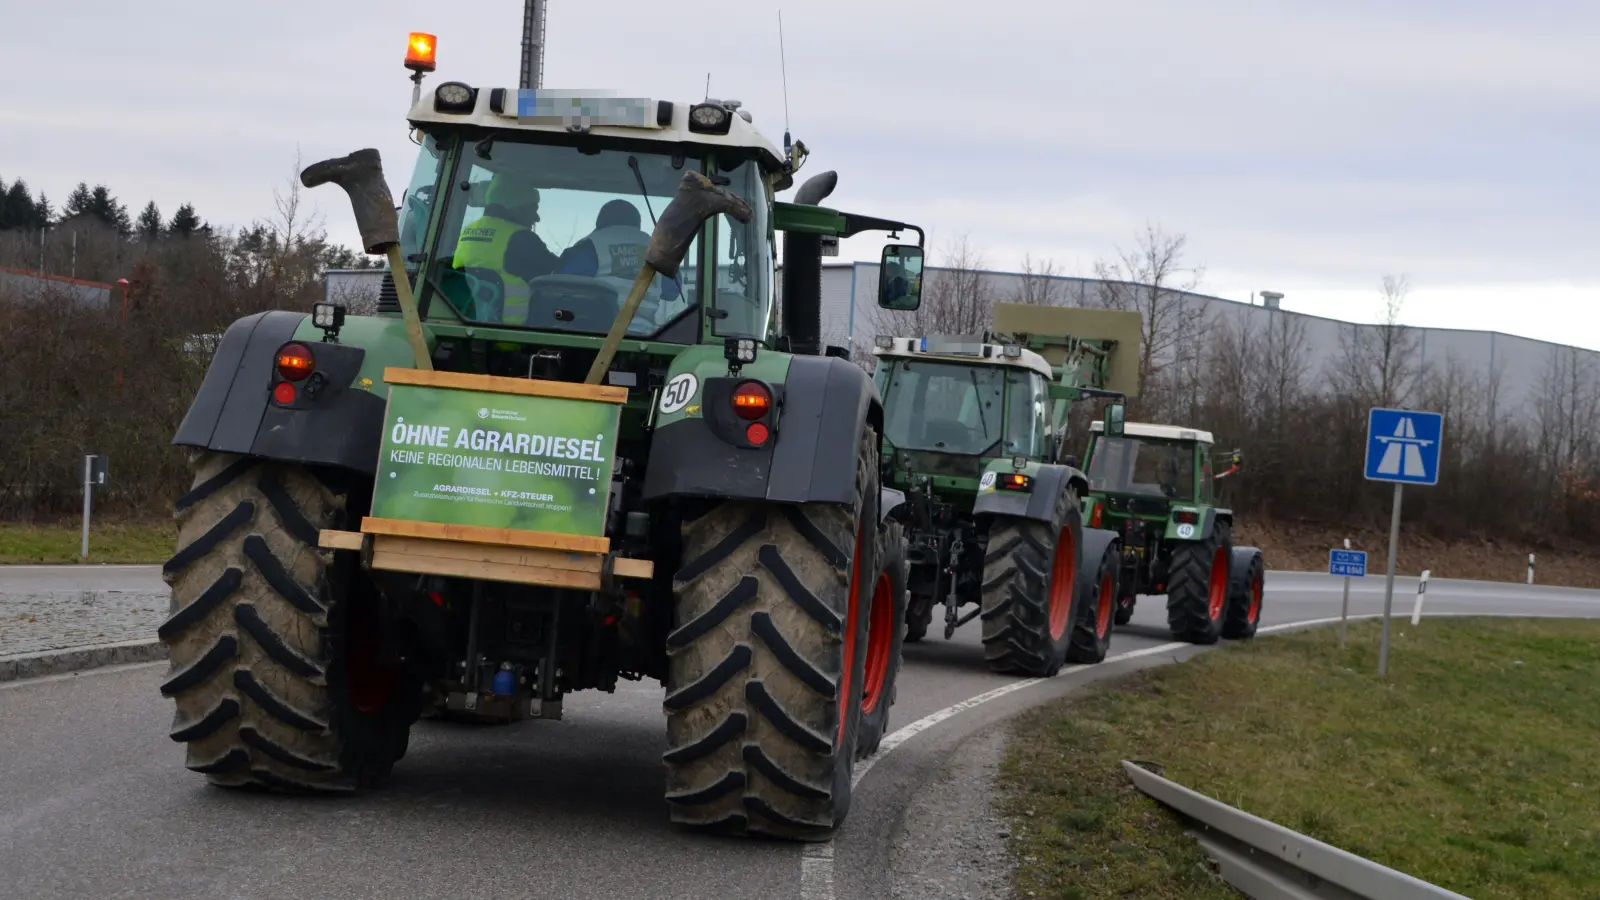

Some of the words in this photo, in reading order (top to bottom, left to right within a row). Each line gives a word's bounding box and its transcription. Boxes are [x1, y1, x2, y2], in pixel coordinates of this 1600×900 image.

[664, 378, 690, 408] 50
[391, 423, 450, 448] OHNE
[454, 428, 605, 462] AGRARDIESEL
[390, 449, 425, 465] KEINE
[427, 452, 502, 472] REGIONALEN
[981, 473, 994, 486] 40
[433, 483, 492, 496] AGRARDIESEL
[501, 489, 554, 502] KFZ-STEUER
